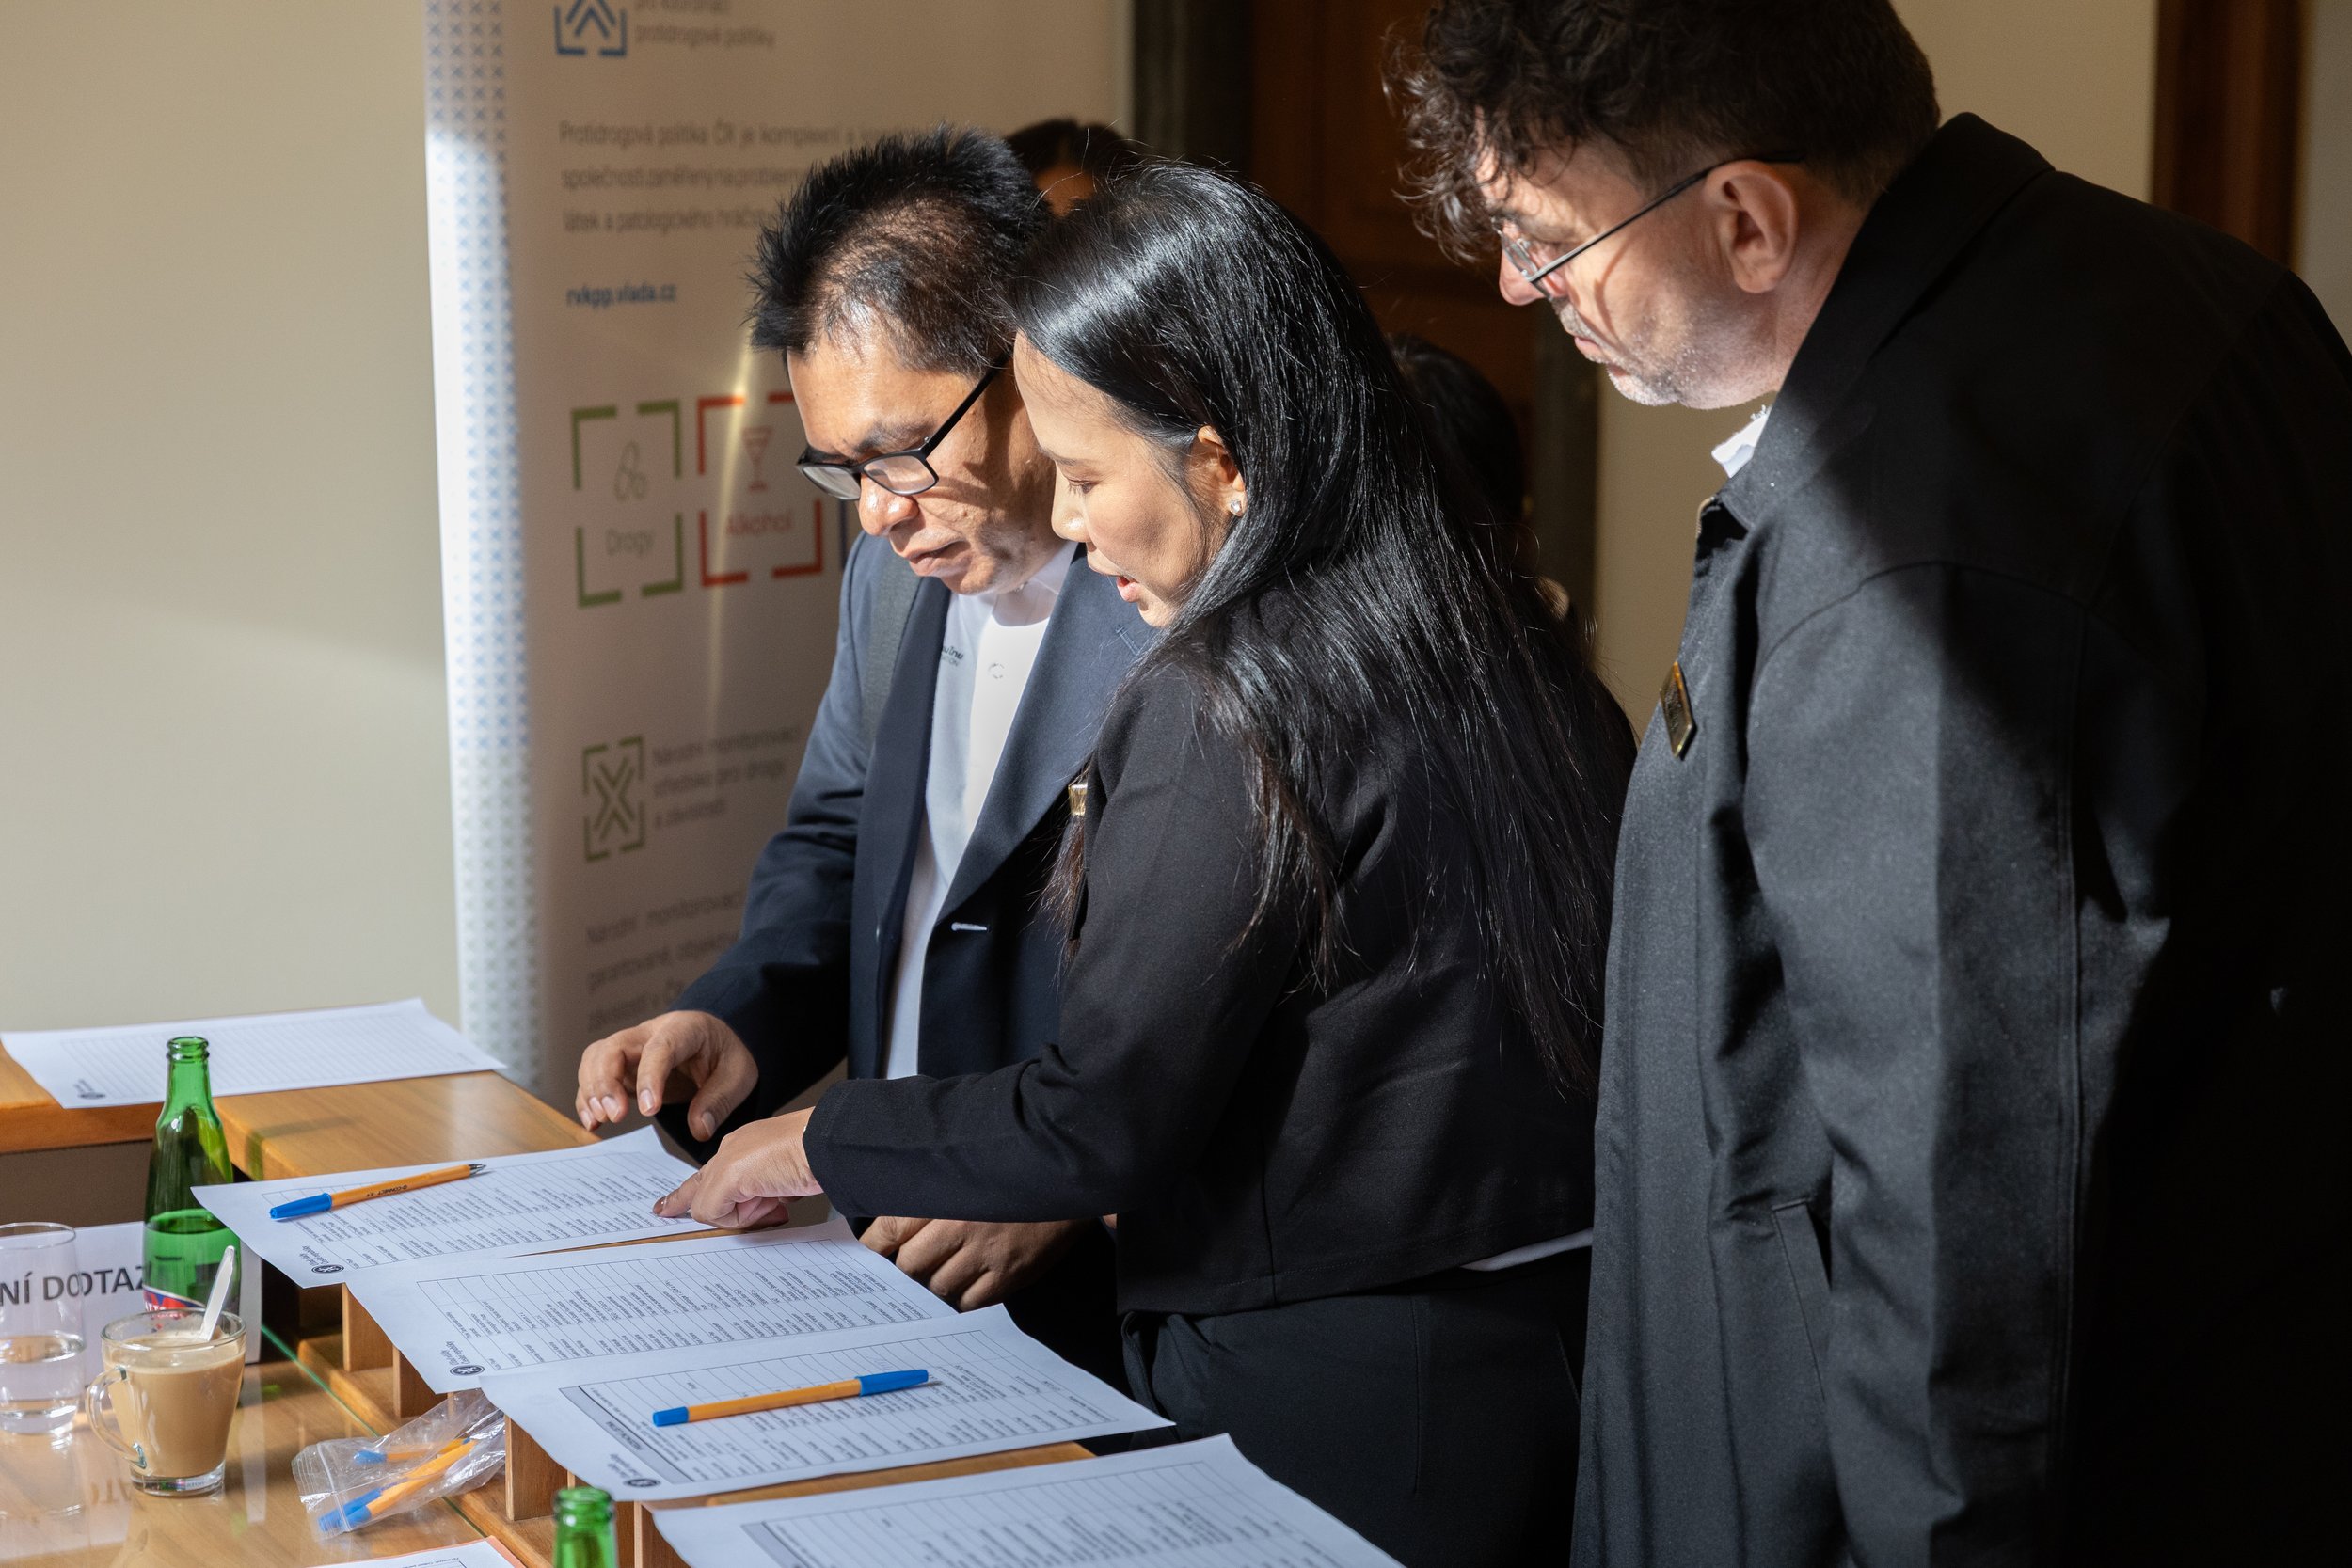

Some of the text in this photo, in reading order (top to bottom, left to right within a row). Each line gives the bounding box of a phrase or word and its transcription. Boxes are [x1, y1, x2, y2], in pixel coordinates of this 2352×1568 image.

[560, 119, 653, 150] Protidrogová
[658, 122, 707, 149] politika
[566, 281, 677, 309] rvkpp.vlada.cz
[606, 529, 656, 558] Drogy
